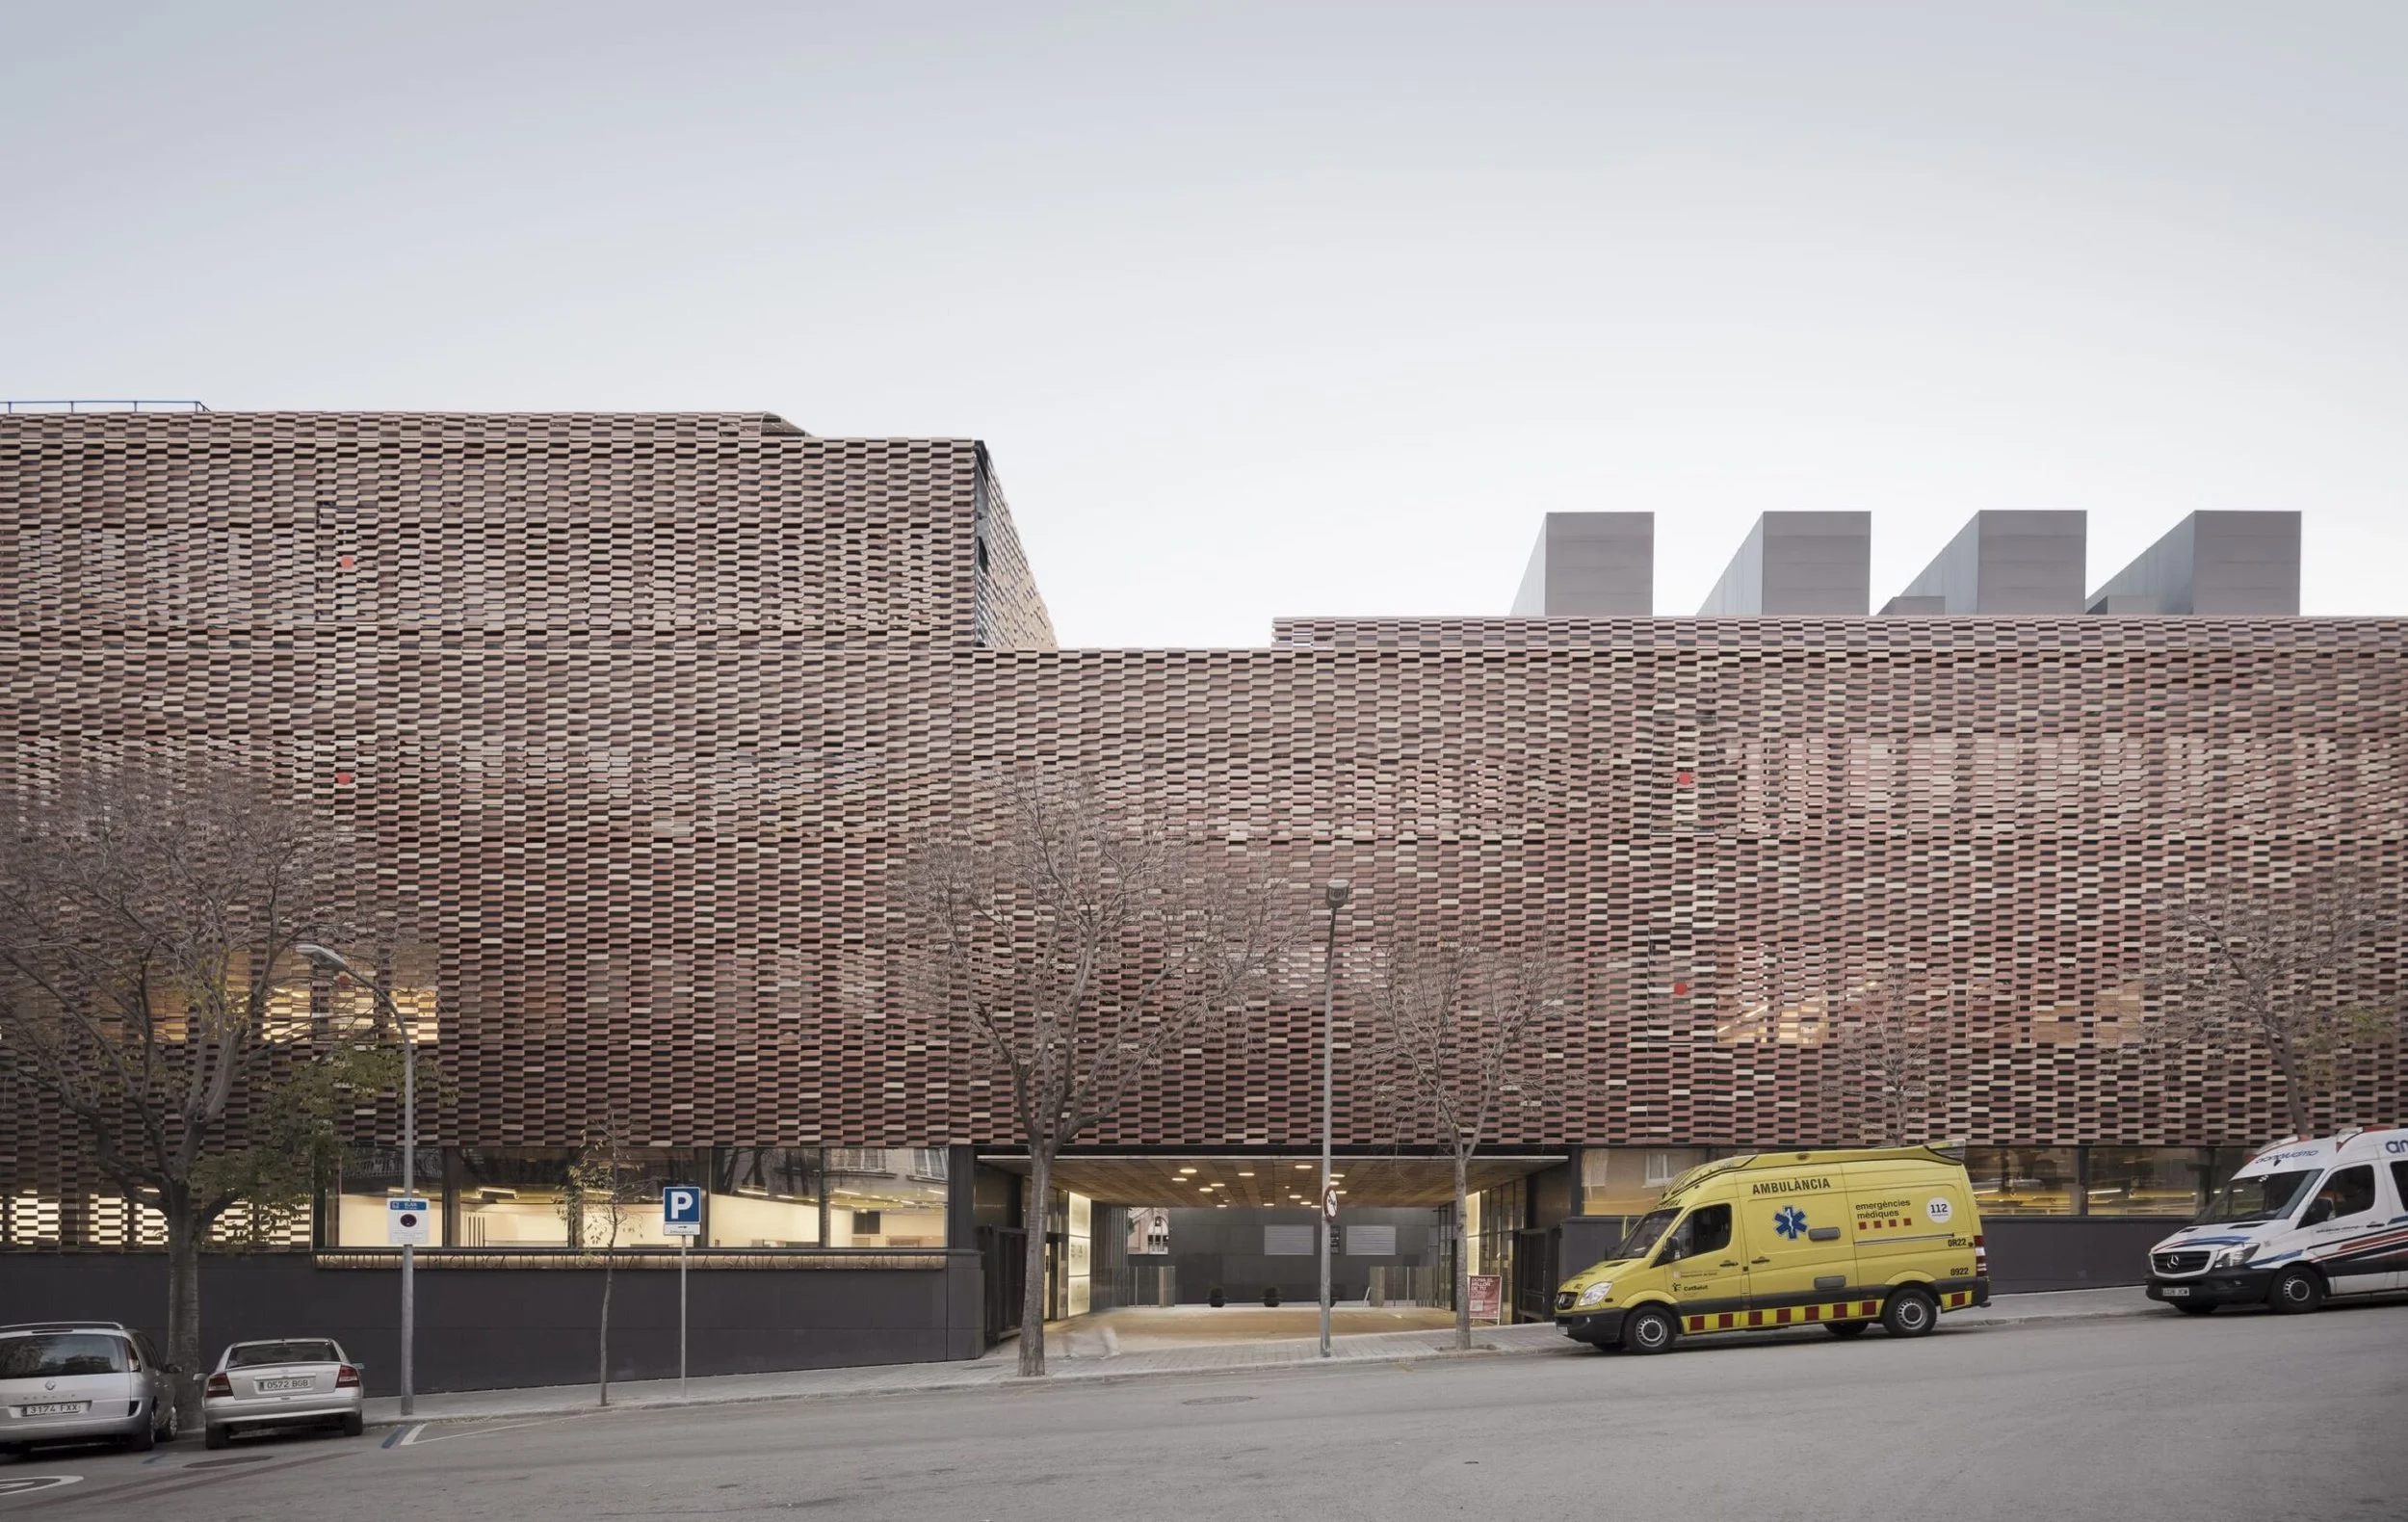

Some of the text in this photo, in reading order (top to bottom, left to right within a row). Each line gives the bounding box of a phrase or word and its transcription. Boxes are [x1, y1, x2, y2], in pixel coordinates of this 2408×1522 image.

[1753, 1178, 1830, 1194] AMBULÀNCIA
[671, 1192, 693, 1220] P
[1930, 1203, 1948, 1214] 112
[30, 1405, 56, 1414] 3174
